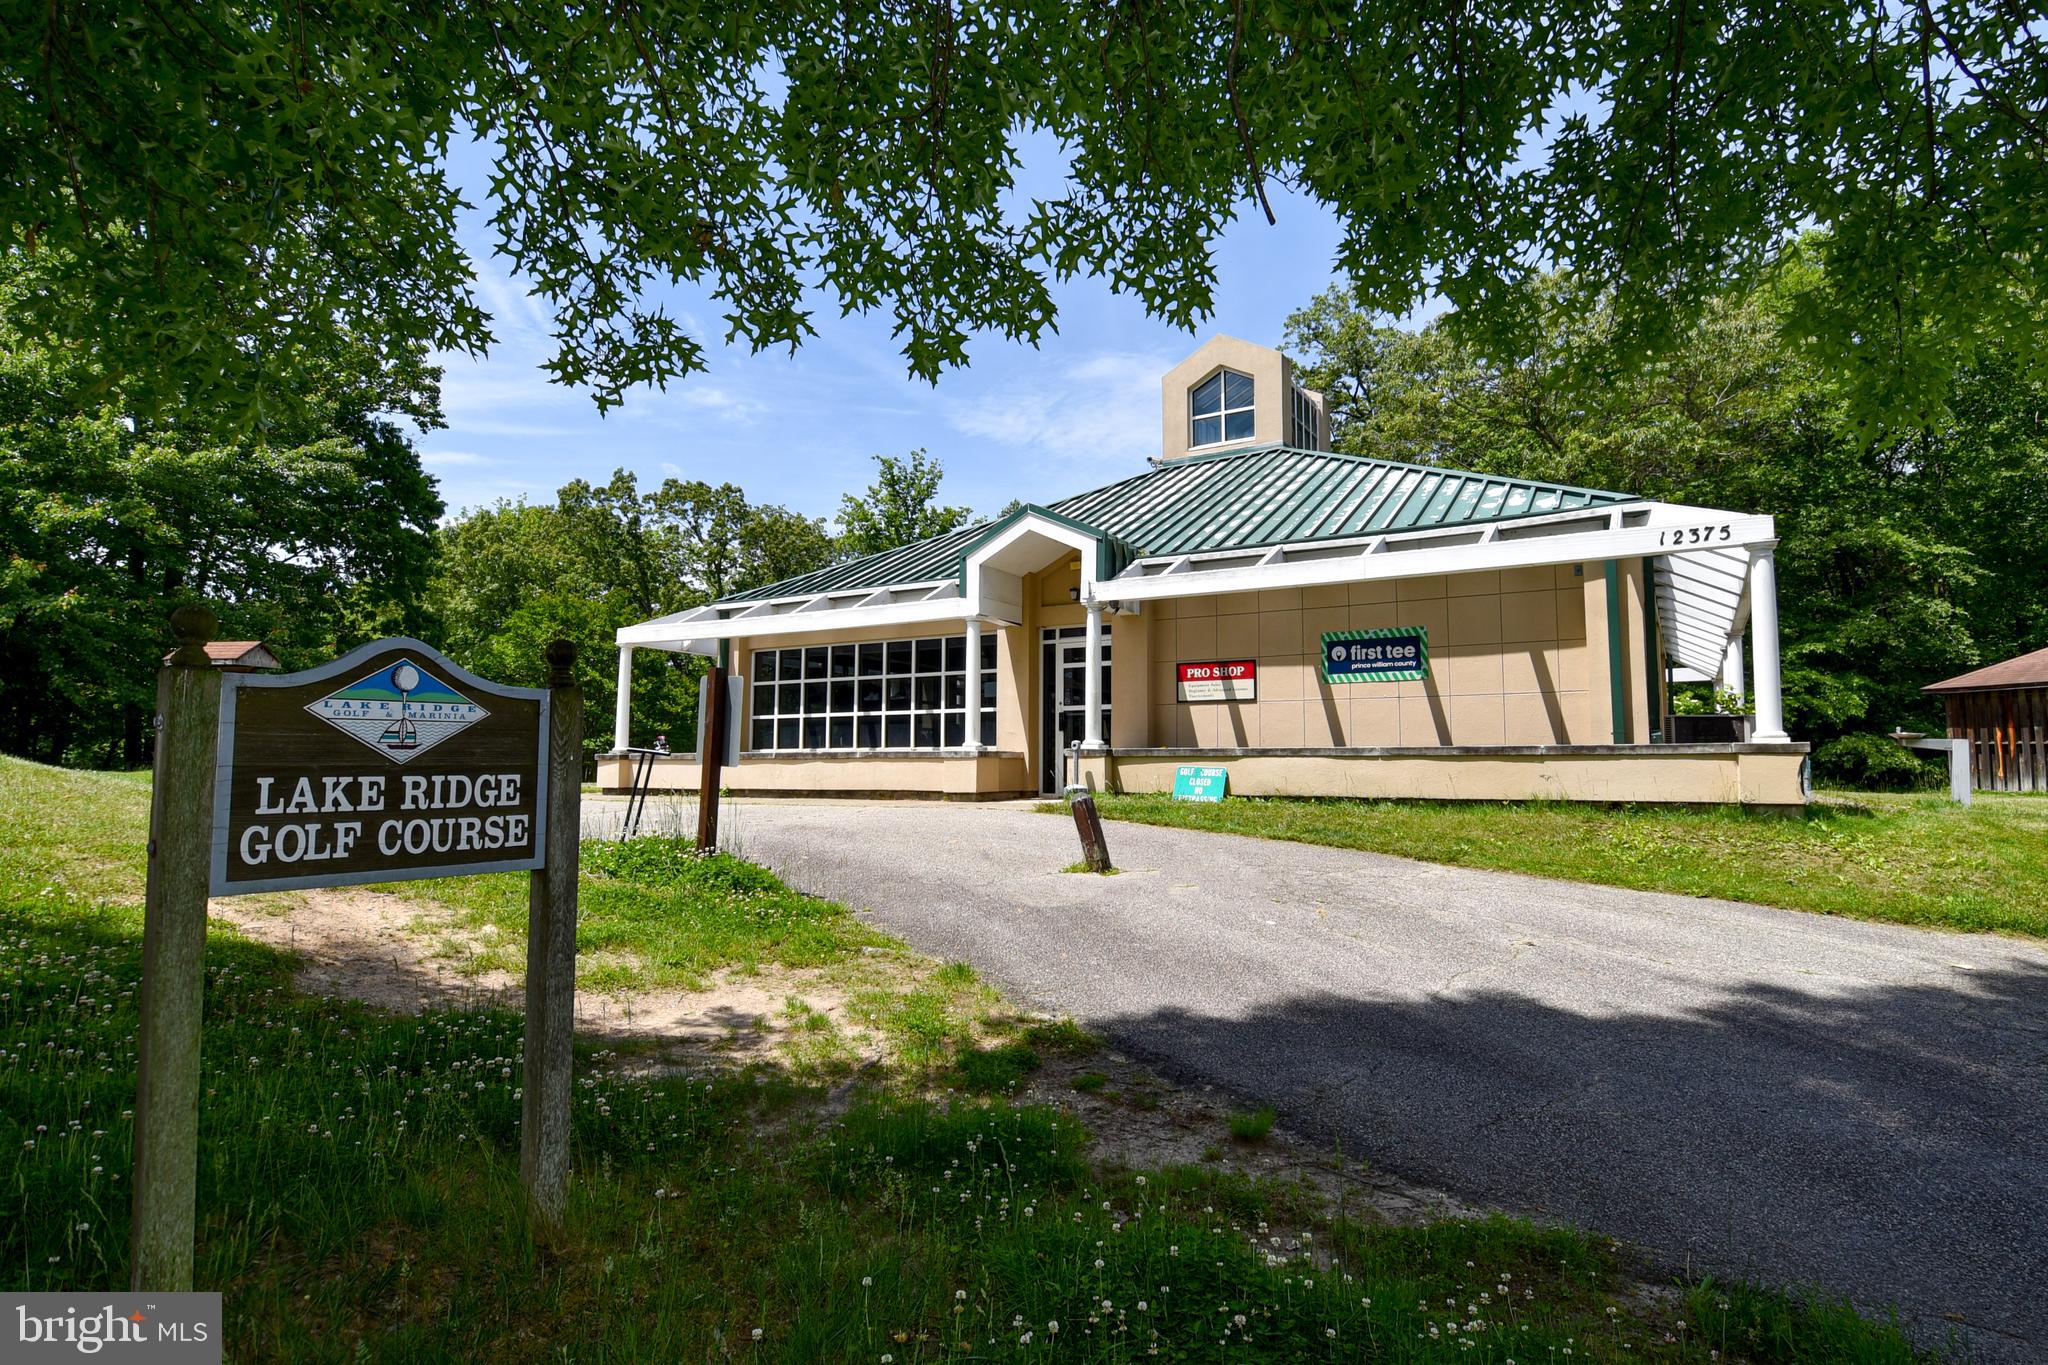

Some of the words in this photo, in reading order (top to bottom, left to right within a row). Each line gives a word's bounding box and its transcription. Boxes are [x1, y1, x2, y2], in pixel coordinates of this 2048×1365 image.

[1659, 525, 1731, 546] 12375
[1350, 645, 1383, 660] first
[1386, 644, 1416, 659] tee
[1351, 662, 1371, 670] prince
[1394, 660, 1417, 668] county
[1186, 668, 1210, 678] PRO
[1212, 666, 1245, 677] SHOP
[323, 700, 390, 711] LAKE
[402, 703, 477, 713] RIDGE
[333, 709, 370, 717] GOLF
[1179, 768, 1195, 776] GOLF
[1200, 769, 1223, 777] COURSE
[1189, 778, 1211, 786] CLOSED
[255, 776, 386, 816] LAKE
[400, 774, 522, 810] RIDGE
[239, 821, 362, 866] GOLF
[378, 814, 530, 856] COURSE
